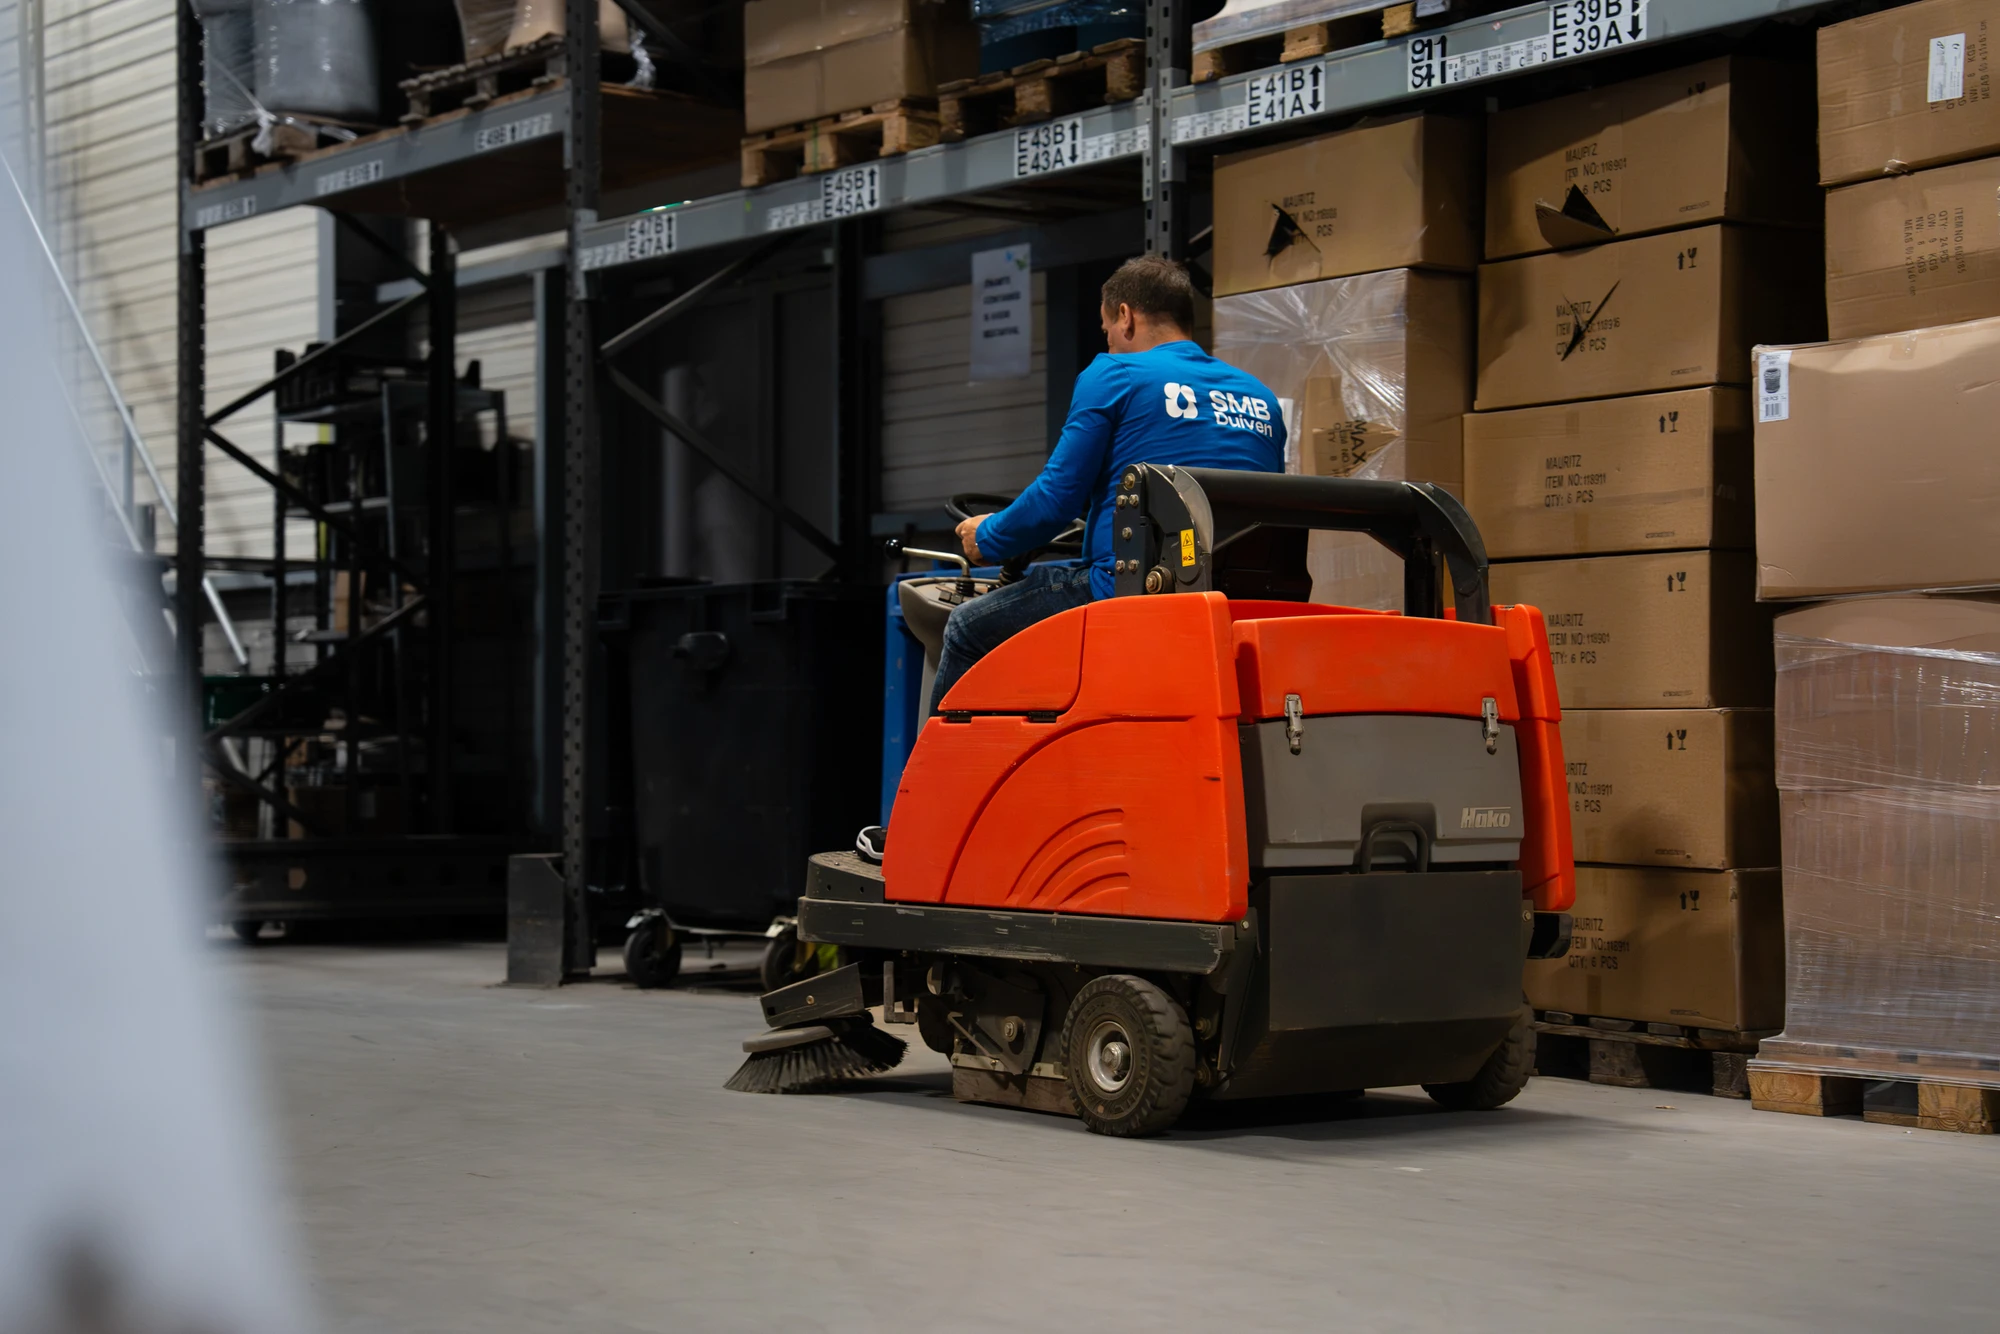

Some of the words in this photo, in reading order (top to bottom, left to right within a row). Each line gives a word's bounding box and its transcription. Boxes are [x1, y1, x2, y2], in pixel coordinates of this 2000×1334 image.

[1553, 0, 1622, 31] E39B
[1553, 20, 1623, 59] E39A
[1411, 35, 1447, 64] 911
[1541, 51, 1547, 62] D
[1497, 61, 1503, 71] B
[1519, 56, 1525, 67] C
[1475, 66, 1481, 76] A
[1250, 68, 1305, 101] E41B
[1249, 93, 1305, 126] E41A
[1018, 123, 1066, 153] E43B
[1018, 147, 1066, 176] E43A
[824, 170, 865, 197] E45B
[1593, 178, 1611, 194] PCS
[824, 192, 866, 218] E45A
[1317, 224, 1333, 237] PCS
[1939, 237, 1949, 248] 24
[1557, 322, 1571, 337] ITEM
[1590, 337, 1606, 352] PCS
[1208, 389, 1271, 421] SMB
[1213, 411, 1273, 438] Duiven
[1350, 420, 1367, 465] MAX
[1545, 454, 1582, 470] MAURITZ
[1545, 475, 1564, 489] ITEM
[1545, 494, 1564, 508] QTY:
[1576, 489, 1594, 504] PCS
[1548, 612, 1584, 627] MAURITZ
[1548, 632, 1567, 646] ITEM
[1571, 653, 1576, 664] 6
[1580, 651, 1597, 665] PCS
[1565, 762, 1587, 776] URITZ
[1575, 800, 1580, 812] 6
[1584, 799, 1602, 813] PCS
[1460, 806, 1511, 829] Hako
[1573, 917, 1604, 932] AURITZ
[1571, 936, 1587, 950] TEM
[1569, 954, 1588, 969] QTY:
[1592, 956, 1597, 968] 6
[1601, 955, 1618, 970] PCS
